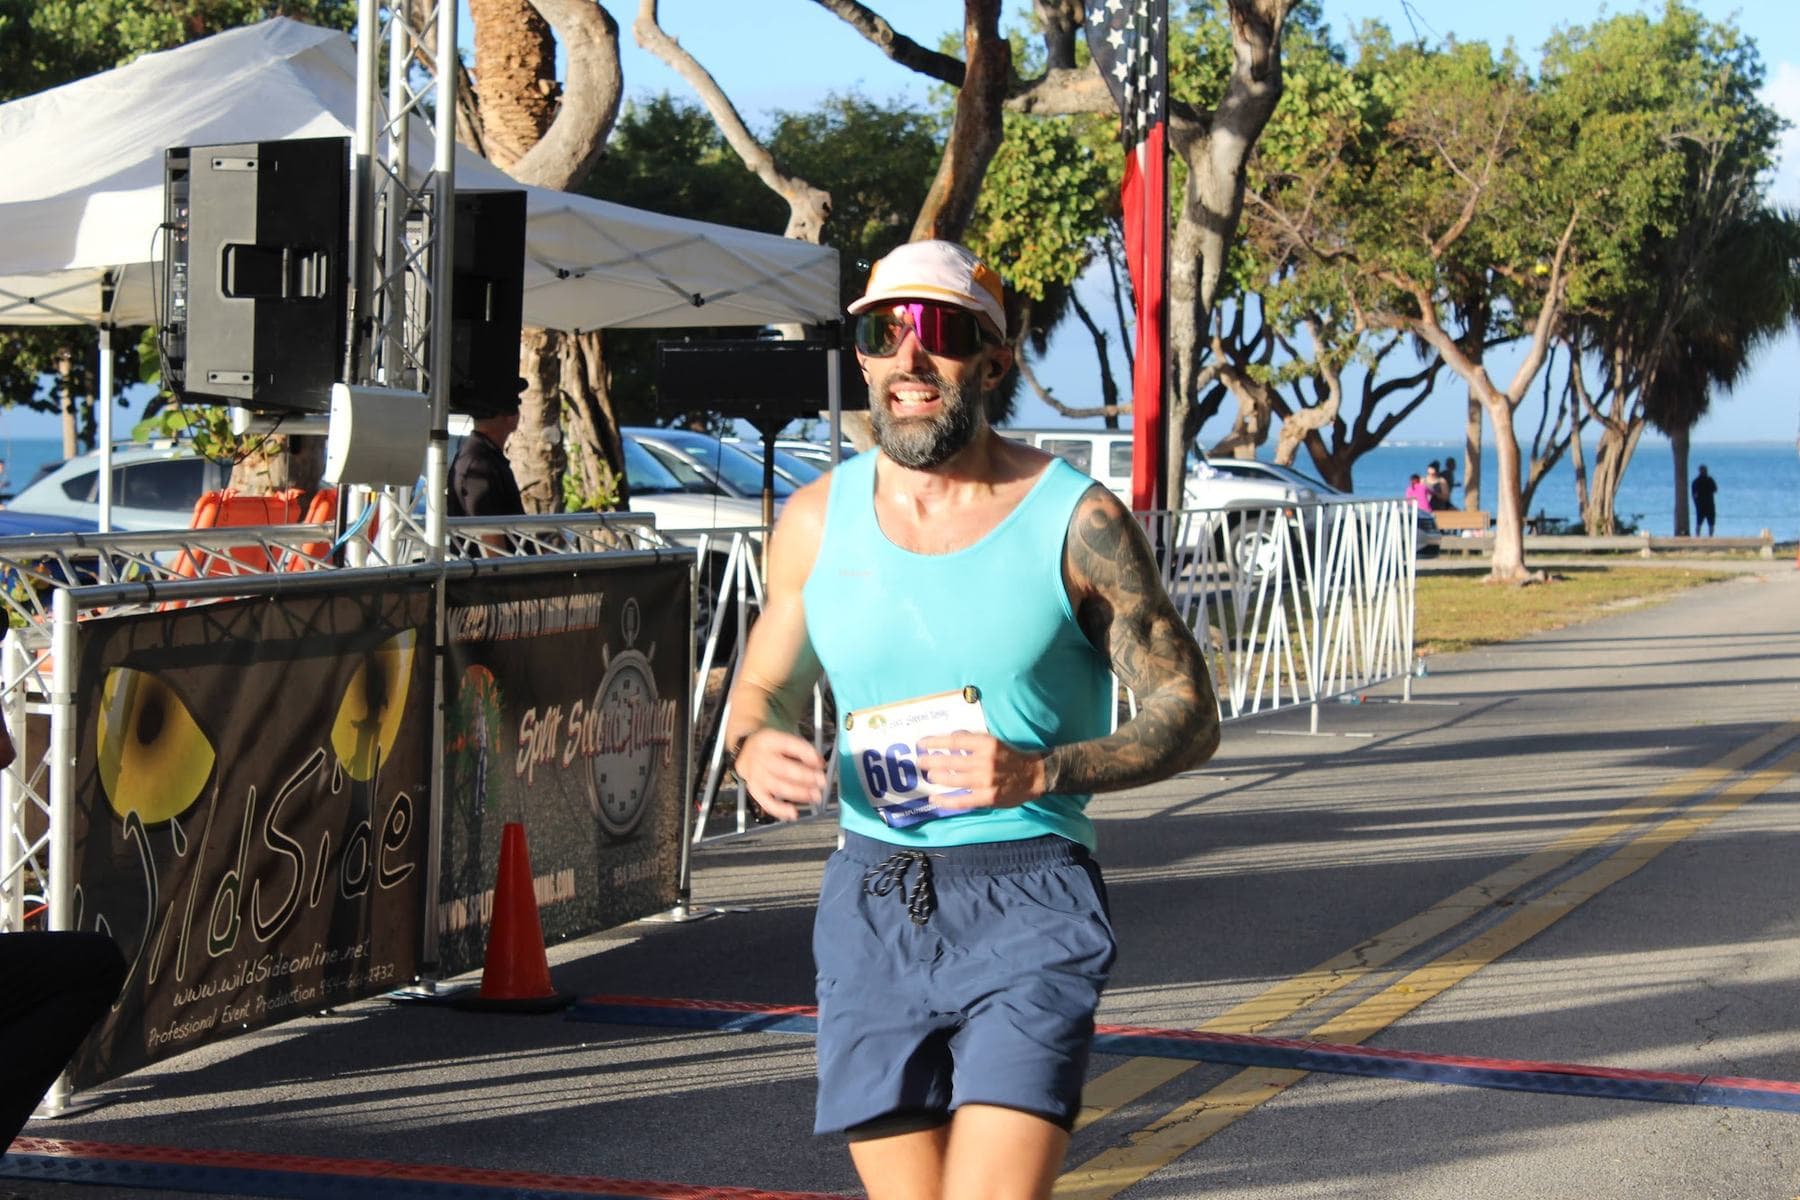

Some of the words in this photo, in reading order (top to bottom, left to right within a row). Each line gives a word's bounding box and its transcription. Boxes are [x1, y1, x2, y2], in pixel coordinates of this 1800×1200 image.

[516, 702, 563, 787] Split
[148, 1008, 216, 1047] Professional
[221, 1000, 250, 1024] Event
[255, 988, 316, 1013] Production
